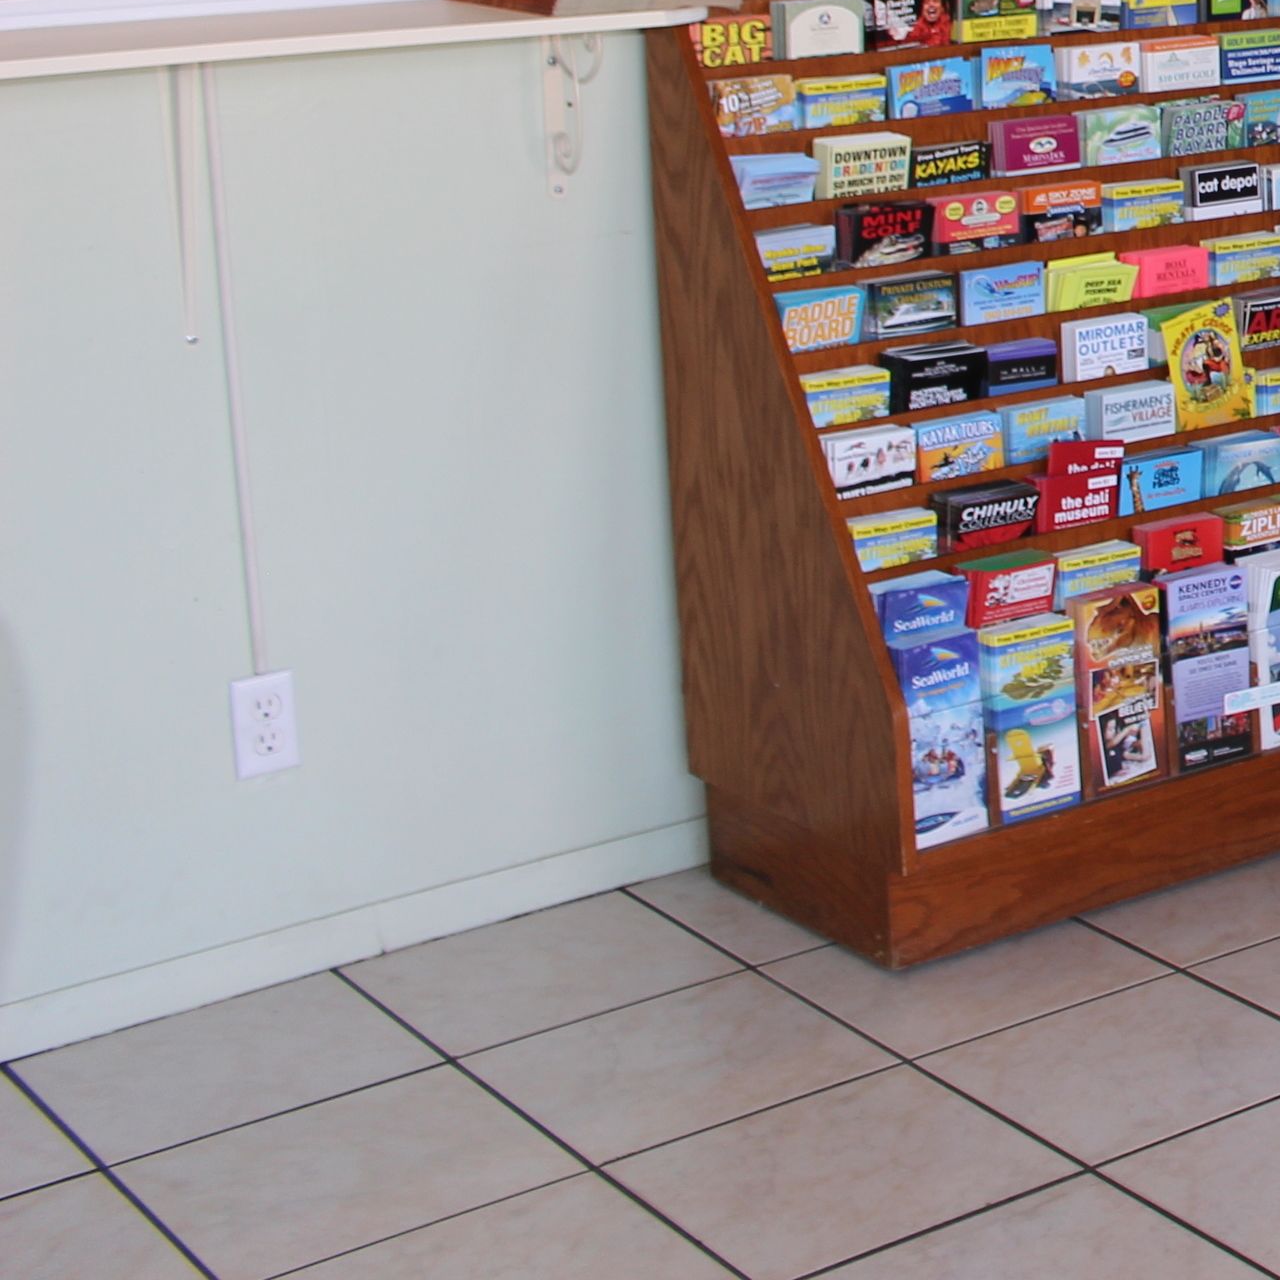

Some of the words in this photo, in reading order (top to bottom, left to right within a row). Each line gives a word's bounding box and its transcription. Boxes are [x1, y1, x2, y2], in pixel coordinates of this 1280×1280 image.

[702, 20, 765, 48] BIG
[702, 44, 764, 68] CAT
[1173, 104, 1230, 129] PADDLE
[1175, 120, 1226, 141] BOARD
[834, 146, 907, 165] DOWNTOWN
[1173, 135, 1224, 155] KAYAK
[833, 159, 906, 178] BRADENTON
[915, 151, 981, 179] KAYAKS
[833, 180, 845, 190] SO
[874, 176, 886, 186] TO
[1199, 178, 1222, 195] cat
[1225, 173, 1257, 193] depot
[862, 209, 922, 227] MINI
[861, 222, 920, 239] GOLF
[1156, 268, 1197, 281] RENTALS
[1165, 259, 1187, 270] BOAT
[787, 295, 857, 324] PADDLE
[784, 318, 854, 348] BOARD
[1077, 320, 1145, 342] MIROMAR
[1171, 324, 1197, 357] PIRATE
[1078, 336, 1145, 356] OUTLETS
[1104, 392, 1172, 416] FISHERMEN'S
[1131, 405, 1172, 423] VILLAGE
[921, 427, 958, 449] KAYAK
[959, 420, 994, 442] TOURS
[961, 495, 1039, 522] CHIHULY
[1061, 496, 1081, 510] the
[1084, 490, 1110, 507] dali
[959, 507, 1035, 532] COLLECTION
[1054, 504, 1109, 525] museum
[1178, 576, 1229, 595] KENNEDY
[1178, 590, 1201, 601] SPACE
[1202, 585, 1229, 598] CENTER
[894, 610, 955, 633] SeaWorld
[911, 663, 970, 690] SeaWorld
